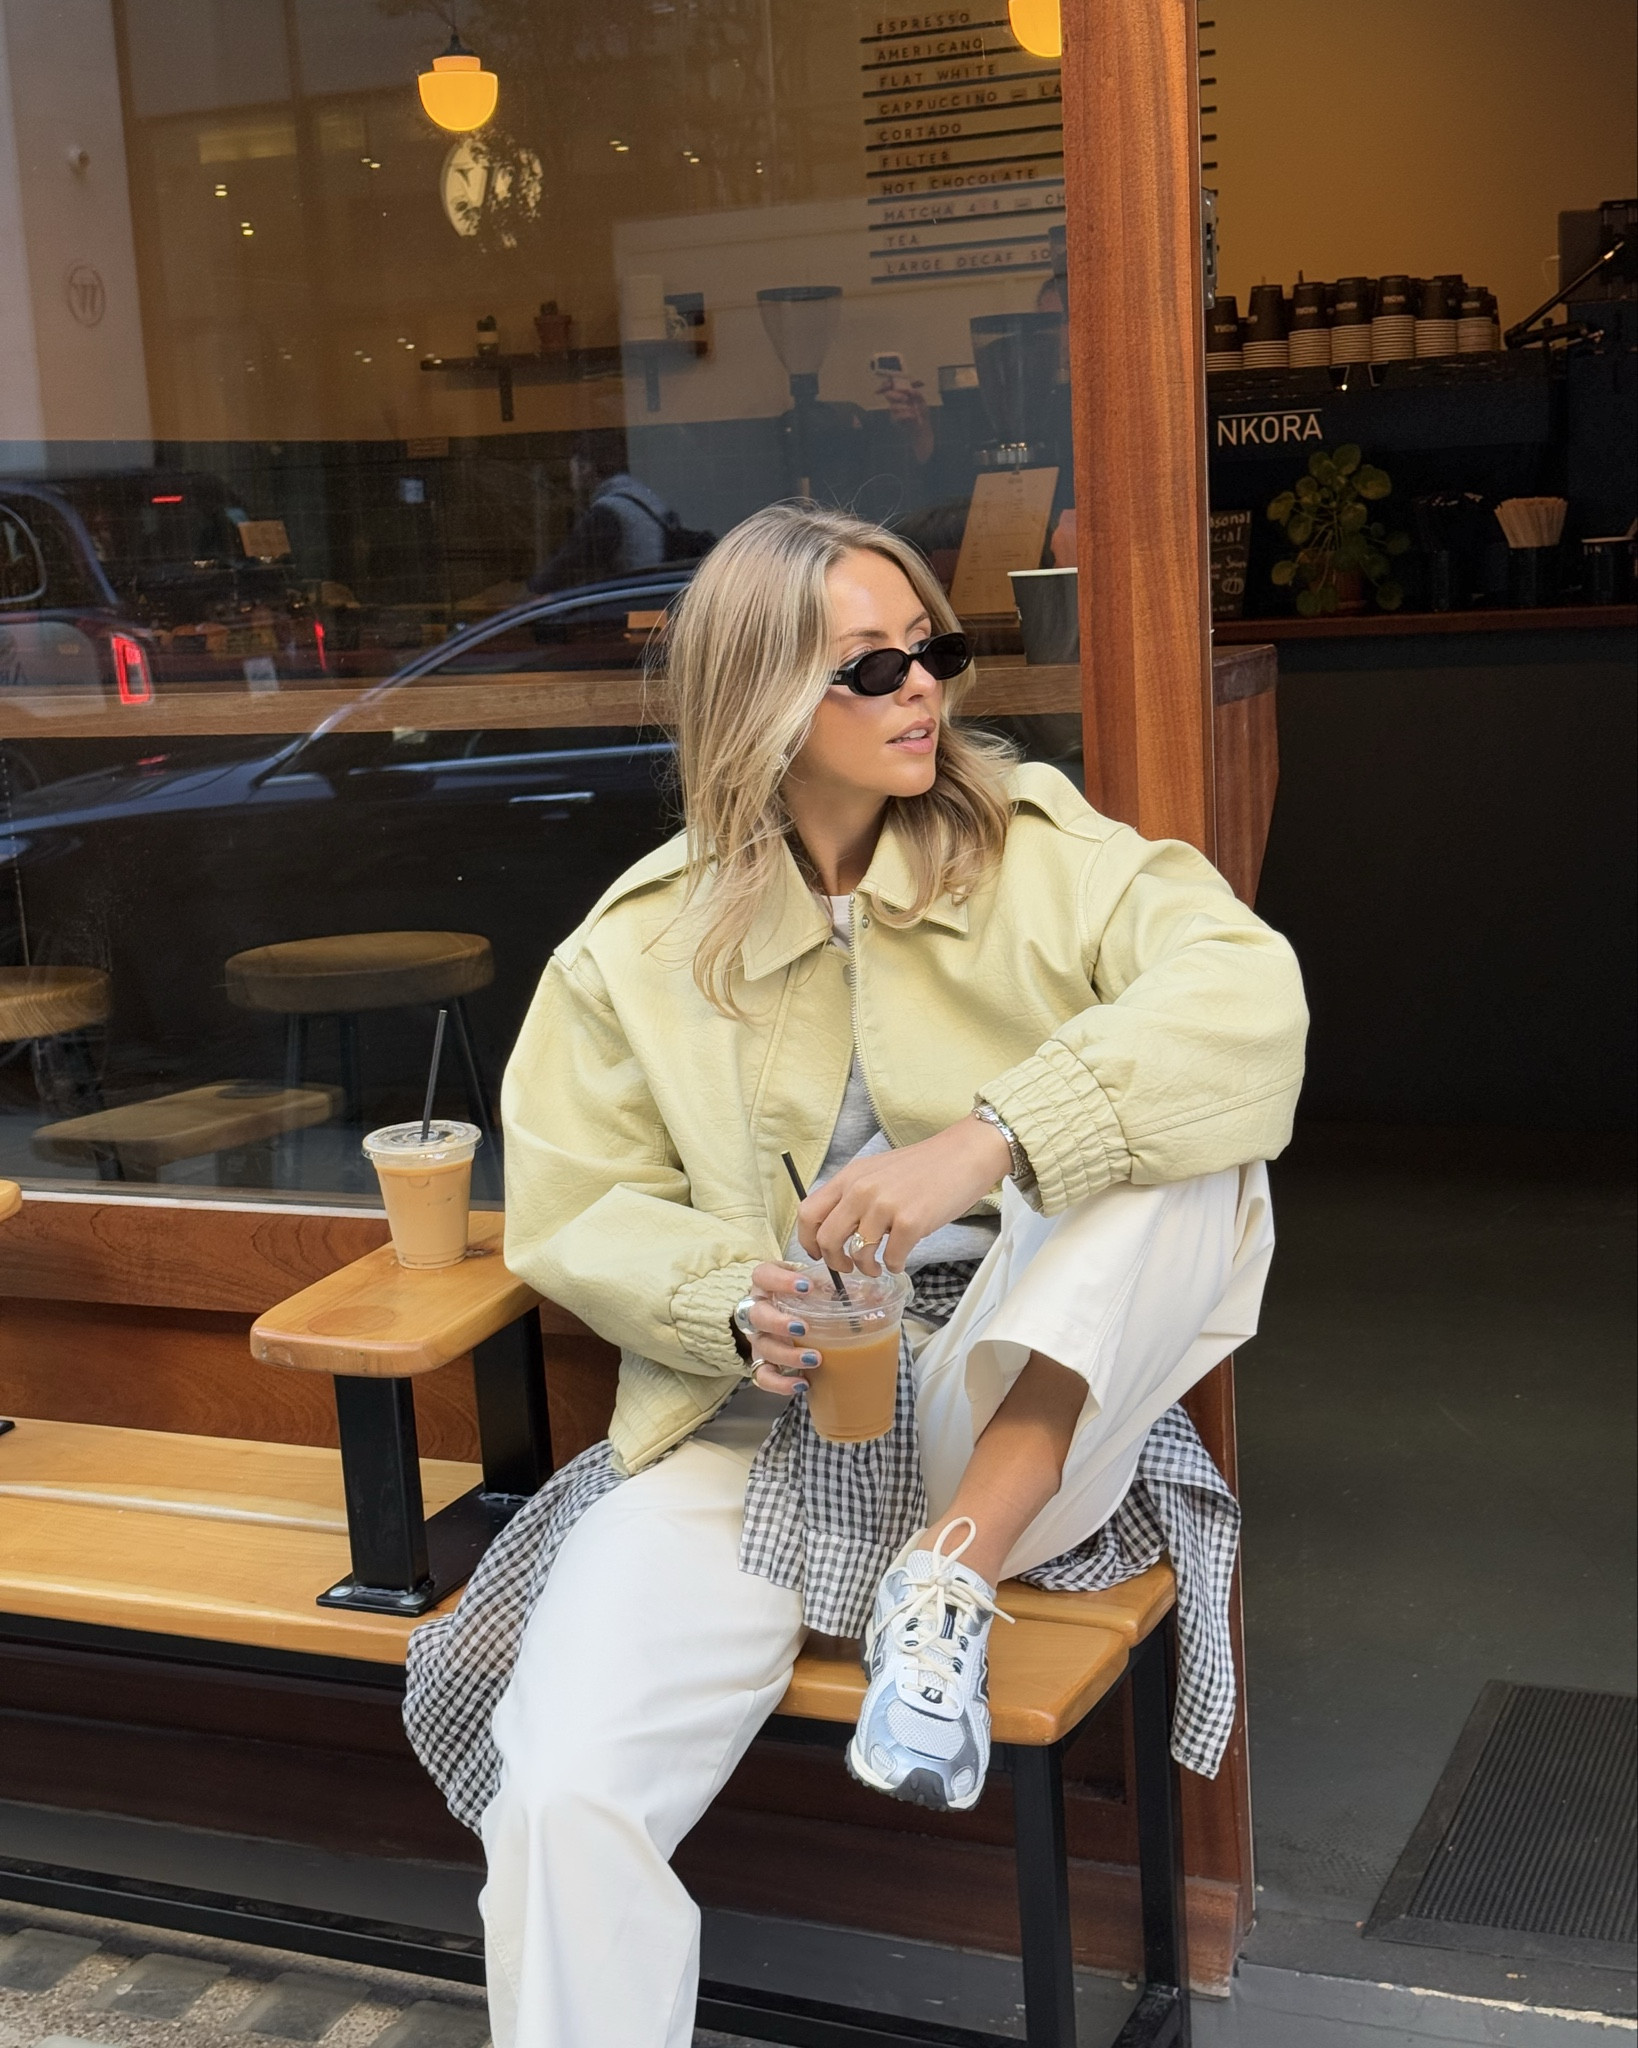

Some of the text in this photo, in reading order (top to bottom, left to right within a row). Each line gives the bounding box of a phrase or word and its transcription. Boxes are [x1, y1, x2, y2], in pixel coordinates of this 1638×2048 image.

[876, 13, 970, 34] ESPRESSO
[877, 37, 983, 61] AMERICANO
[880, 64, 996, 87] FLAT WHITE
[880, 91, 997, 115] CAPPUCCINO
[880, 123, 962, 142] CORTADO
[881, 151, 951, 168] FILTER
[882, 169, 1037, 195] HOT CHOCOLATE
[884, 205, 954, 221] MATCHA
[887, 234, 918, 248] TEA
[887, 259, 942, 274] LARGE
[956, 252, 1012, 267] DECAF
[1217, 413, 1323, 447] NKORA
